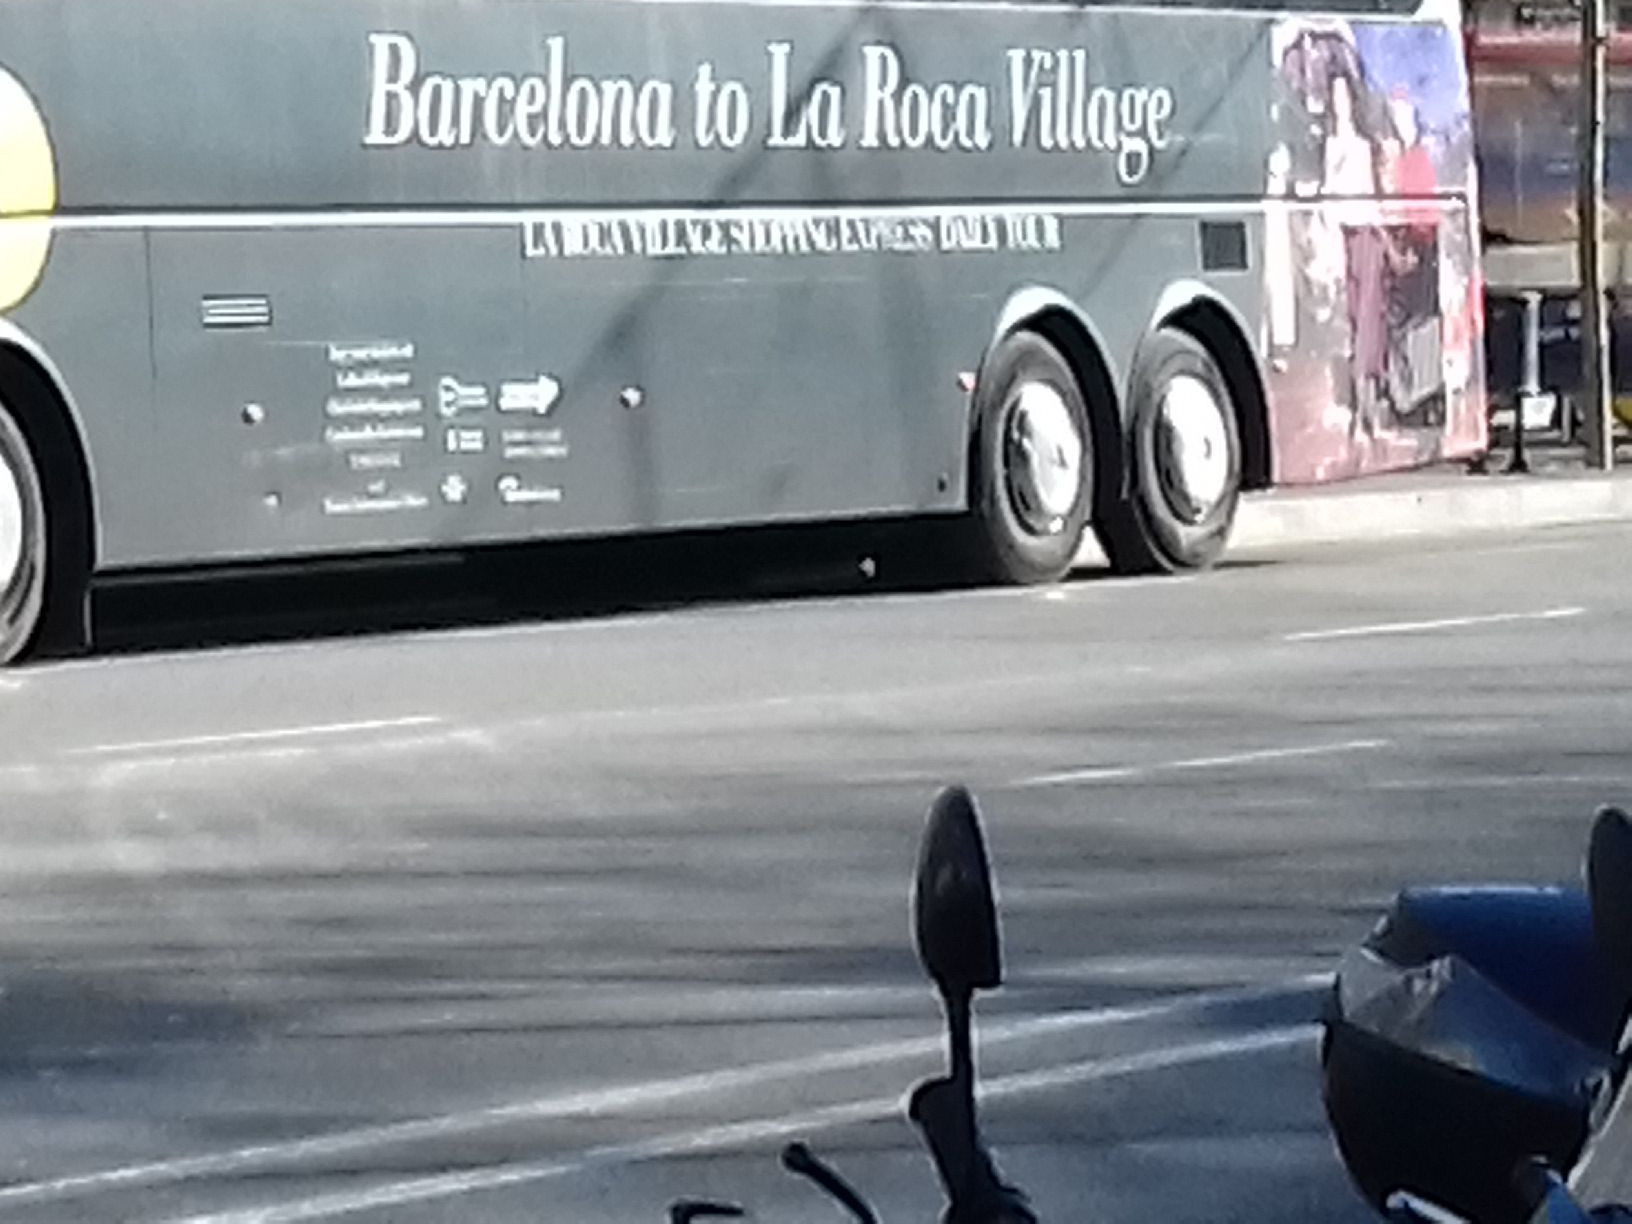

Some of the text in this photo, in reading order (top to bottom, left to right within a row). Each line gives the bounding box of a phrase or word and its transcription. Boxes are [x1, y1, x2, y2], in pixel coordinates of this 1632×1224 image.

[363, 32, 1172, 184] Barcelona to La Roca Village
